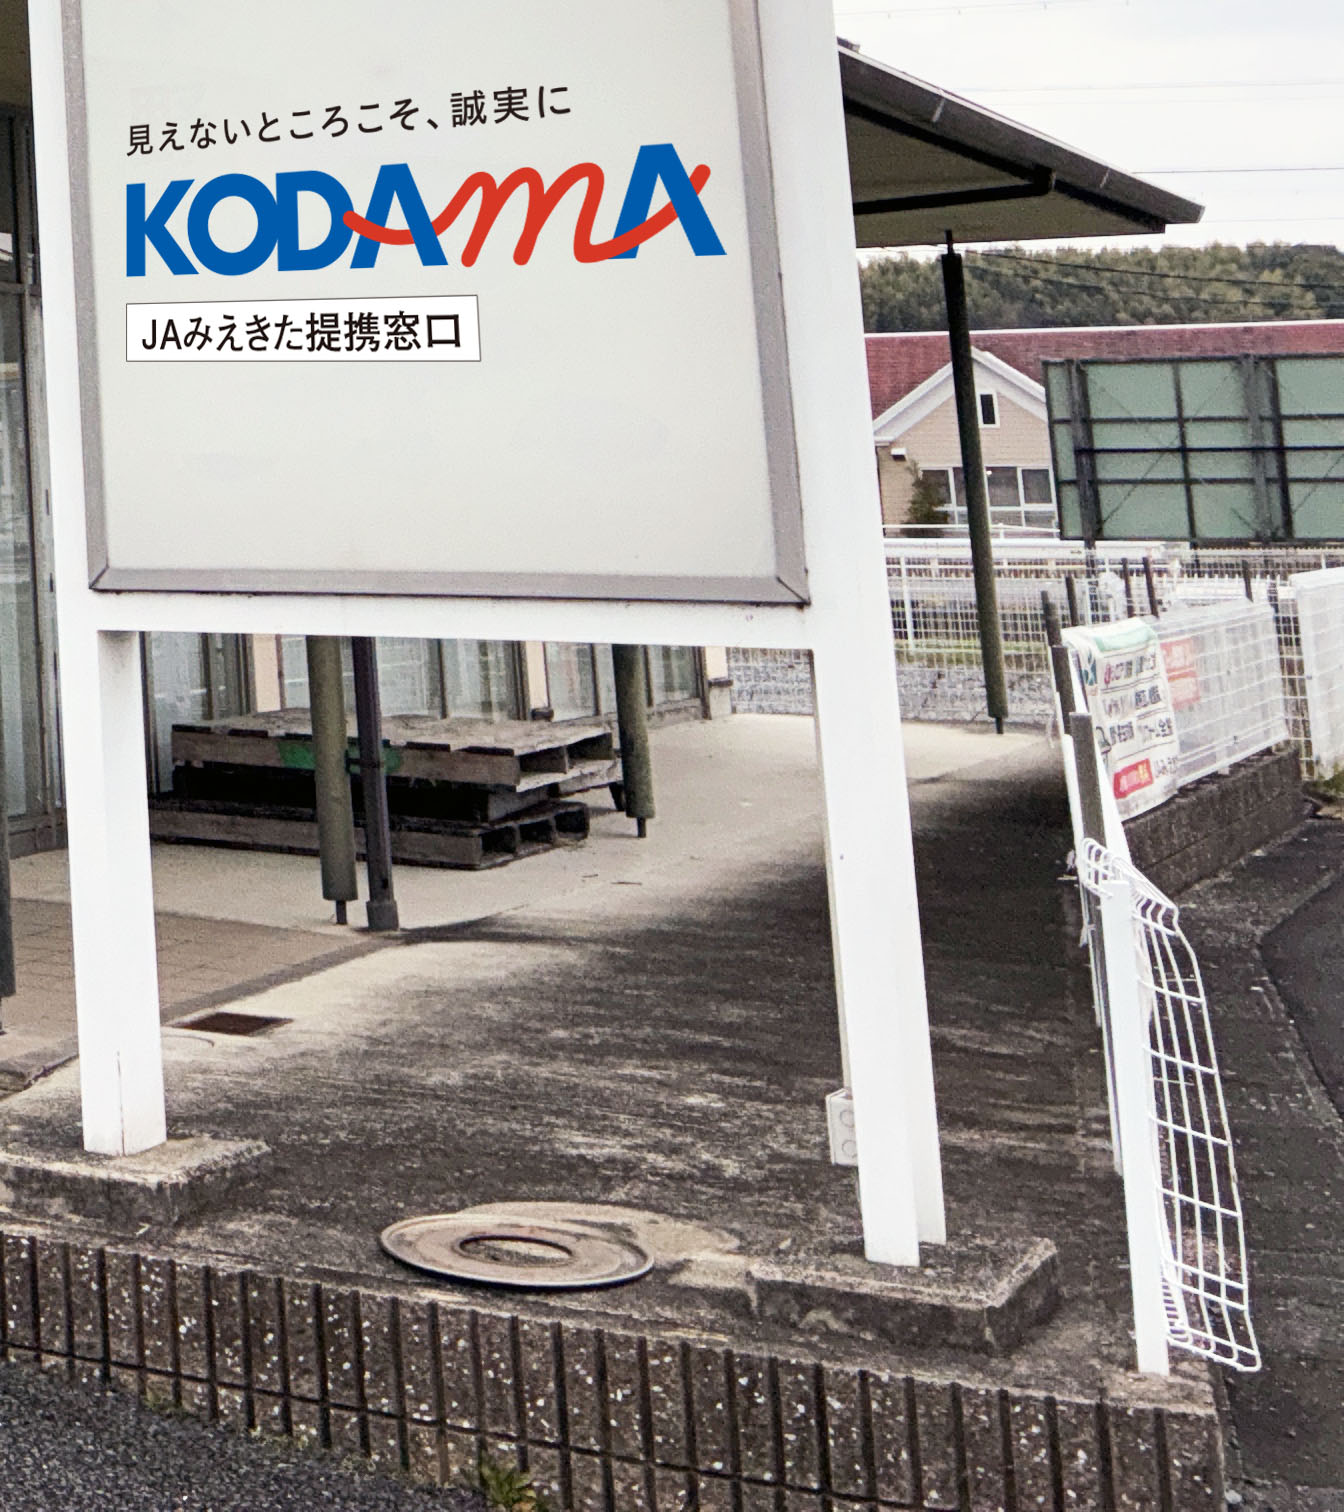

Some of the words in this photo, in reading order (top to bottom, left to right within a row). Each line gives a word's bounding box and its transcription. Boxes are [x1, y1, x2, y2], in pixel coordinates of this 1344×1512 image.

[126, 85, 571, 157] 見えないところこそ、誠実に
[141, 310, 462, 352] JAみえきた提携窓口
